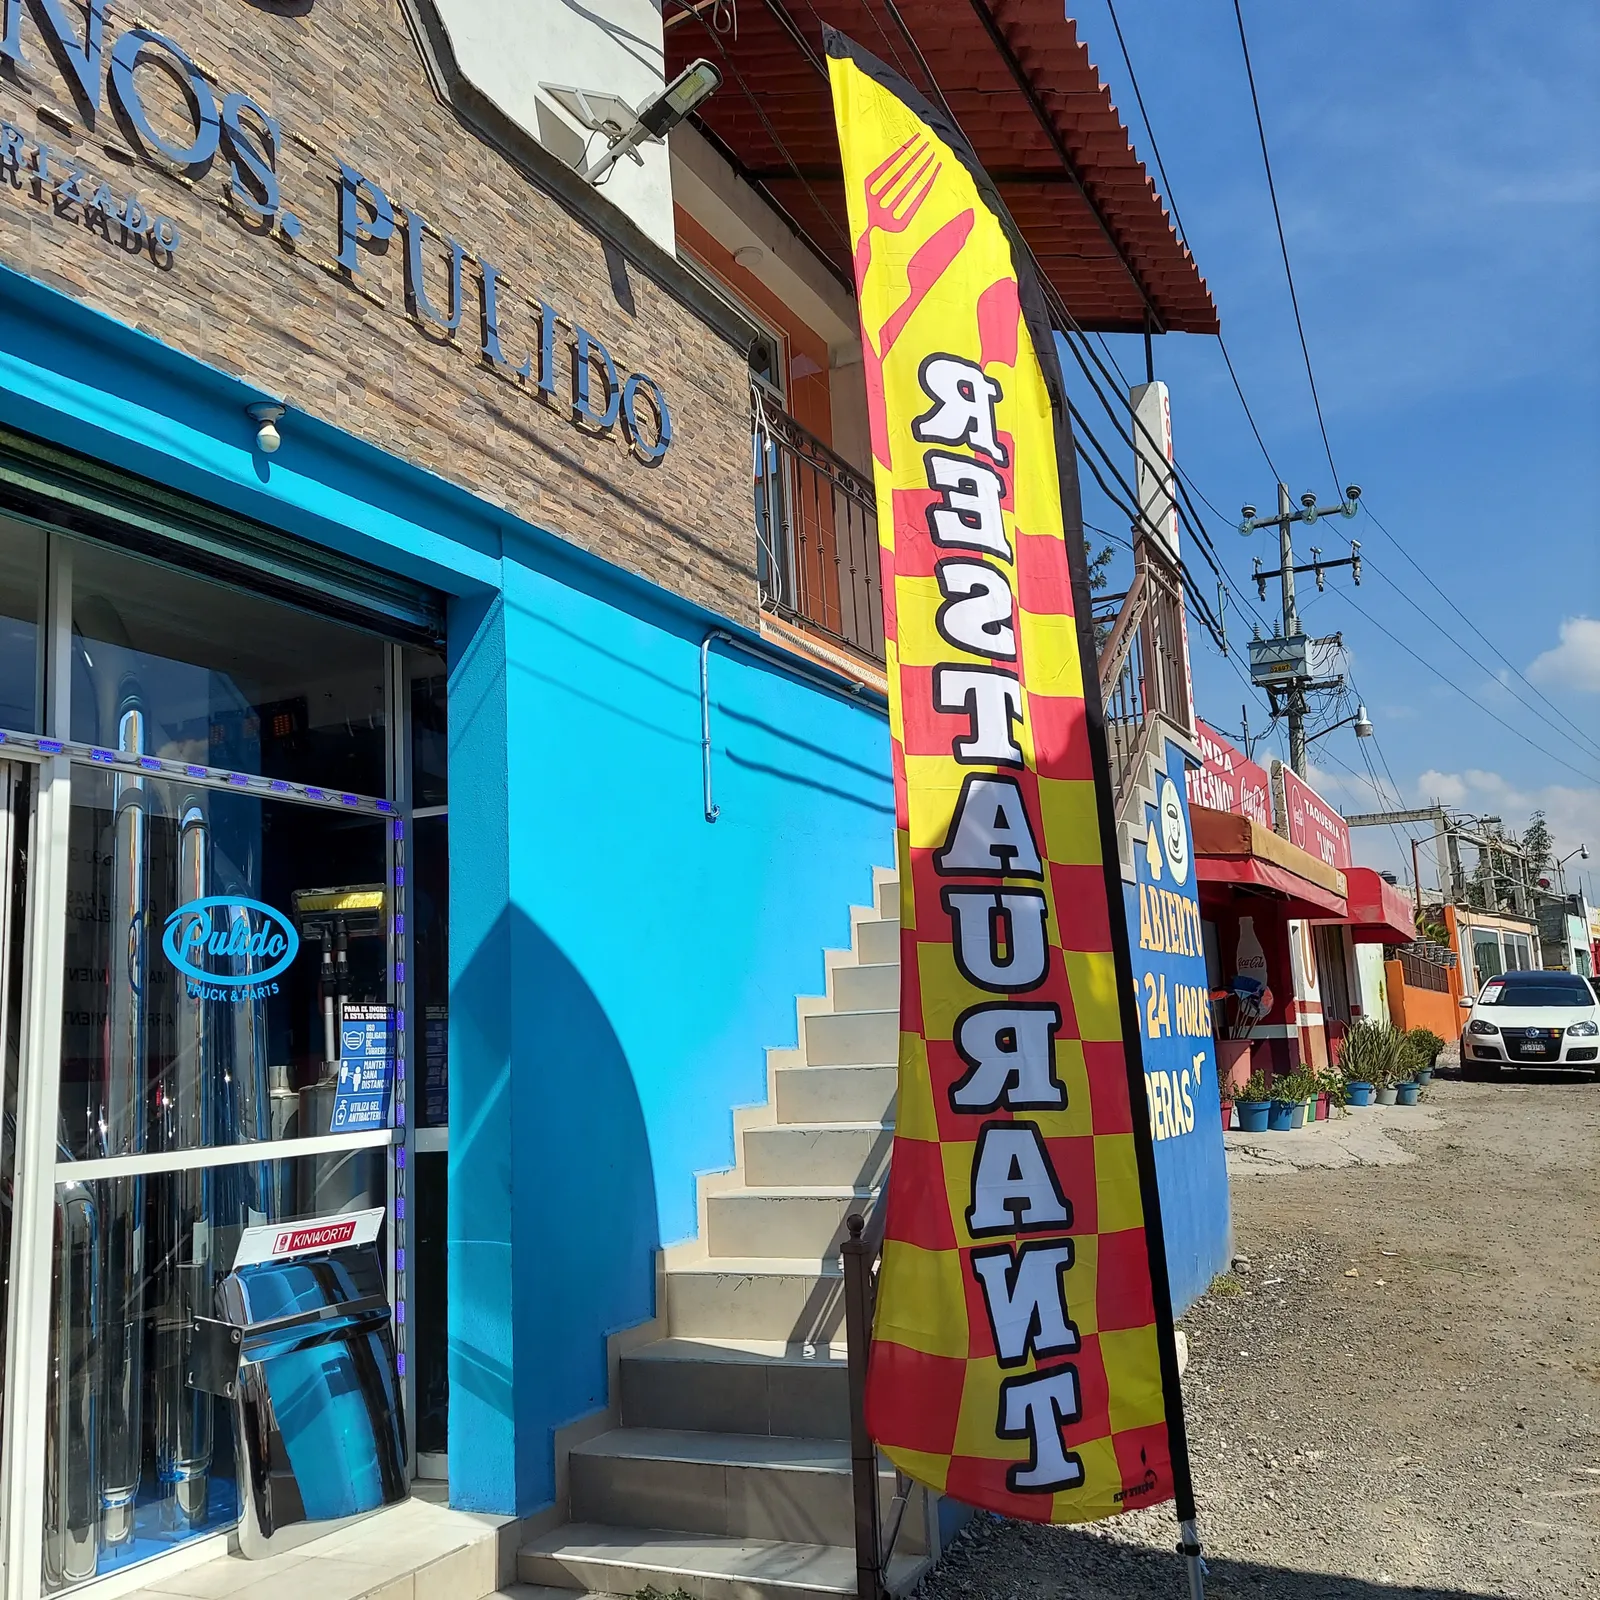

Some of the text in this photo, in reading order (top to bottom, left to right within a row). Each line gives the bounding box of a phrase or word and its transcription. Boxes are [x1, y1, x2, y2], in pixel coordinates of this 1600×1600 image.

[331, 153, 674, 457] PULIDO
[1304, 798, 1341, 841] TAQUERIA
[1139, 882, 1203, 958] ABIERTO
[179, 908, 287, 960] Pulido
[186, 981, 280, 1002] TRUCK & PARTS
[369, 1005, 394, 1013] INGRESO
[1144, 972, 1171, 1039] 24
[1174, 983, 1212, 1038] HORAS
[362, 1070, 378, 1079] SANA
[363, 1060, 392, 1069] MANTENER
[361, 1080, 390, 1089] DISTANCIA
[350, 1101, 379, 1112] UTILIZA GEL
[293, 1225, 352, 1248] KINWORTH
